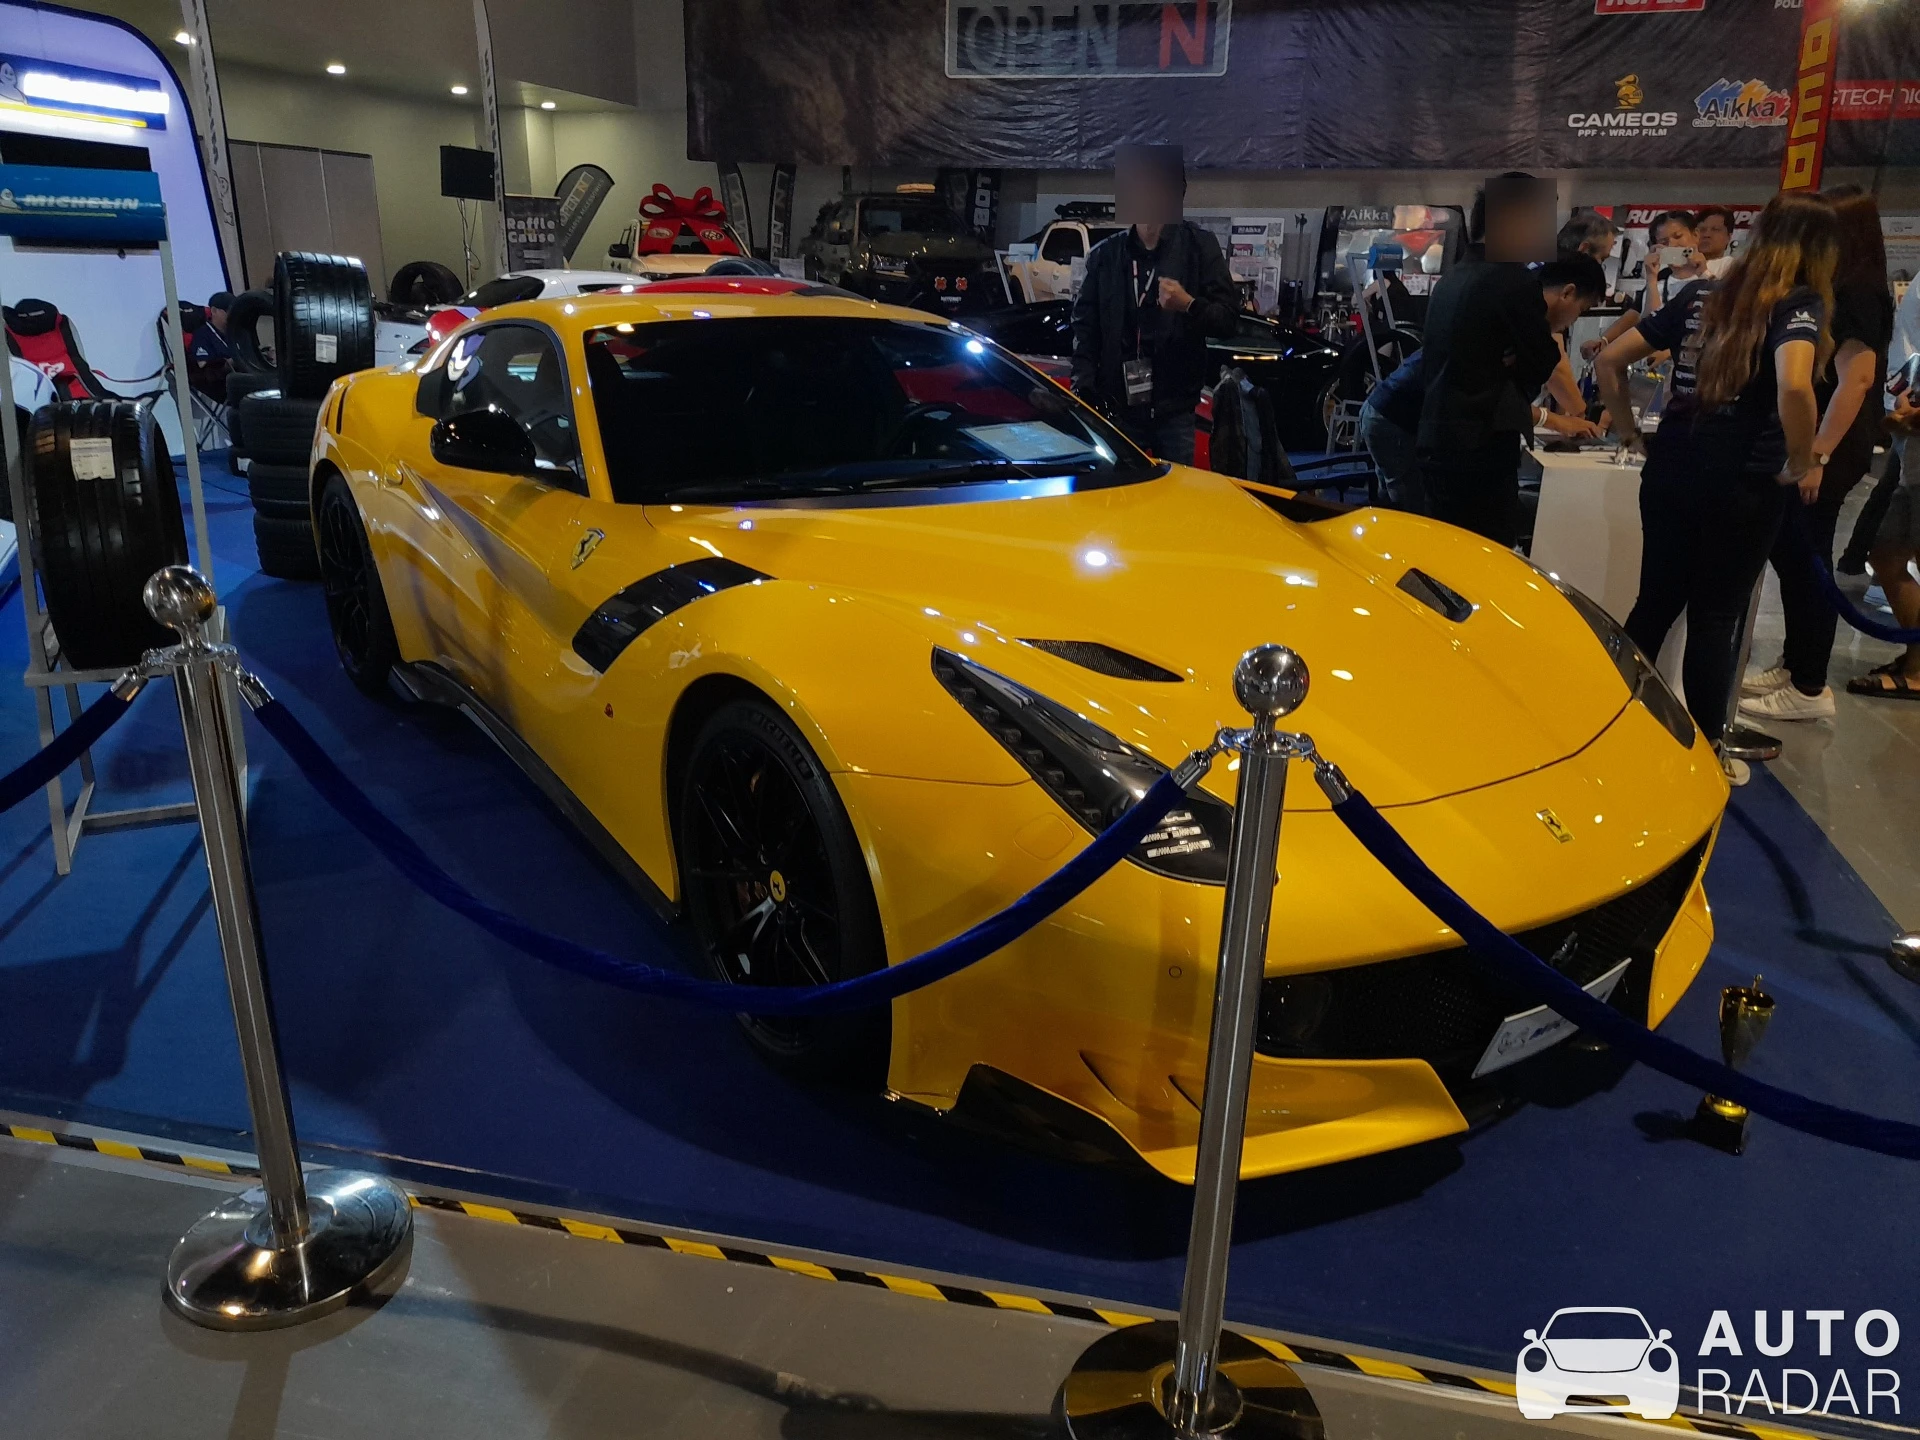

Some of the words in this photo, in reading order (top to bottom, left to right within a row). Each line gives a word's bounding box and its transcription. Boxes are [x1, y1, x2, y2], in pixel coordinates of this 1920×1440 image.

[964, 5, 1119, 74] OPEN
[1159, 0, 1208, 70] N
[1702, 97, 1776, 119] Aikka
[1567, 111, 1678, 129] CAMEOS
[1577, 129, 1598, 137] PPF
[1609, 128, 1640, 137] WRAP
[1642, 128, 1668, 137] FILM
[23, 194, 139, 210] MICHELIN
[507, 216, 556, 230] Raffle
[508, 231, 555, 243] Cause
